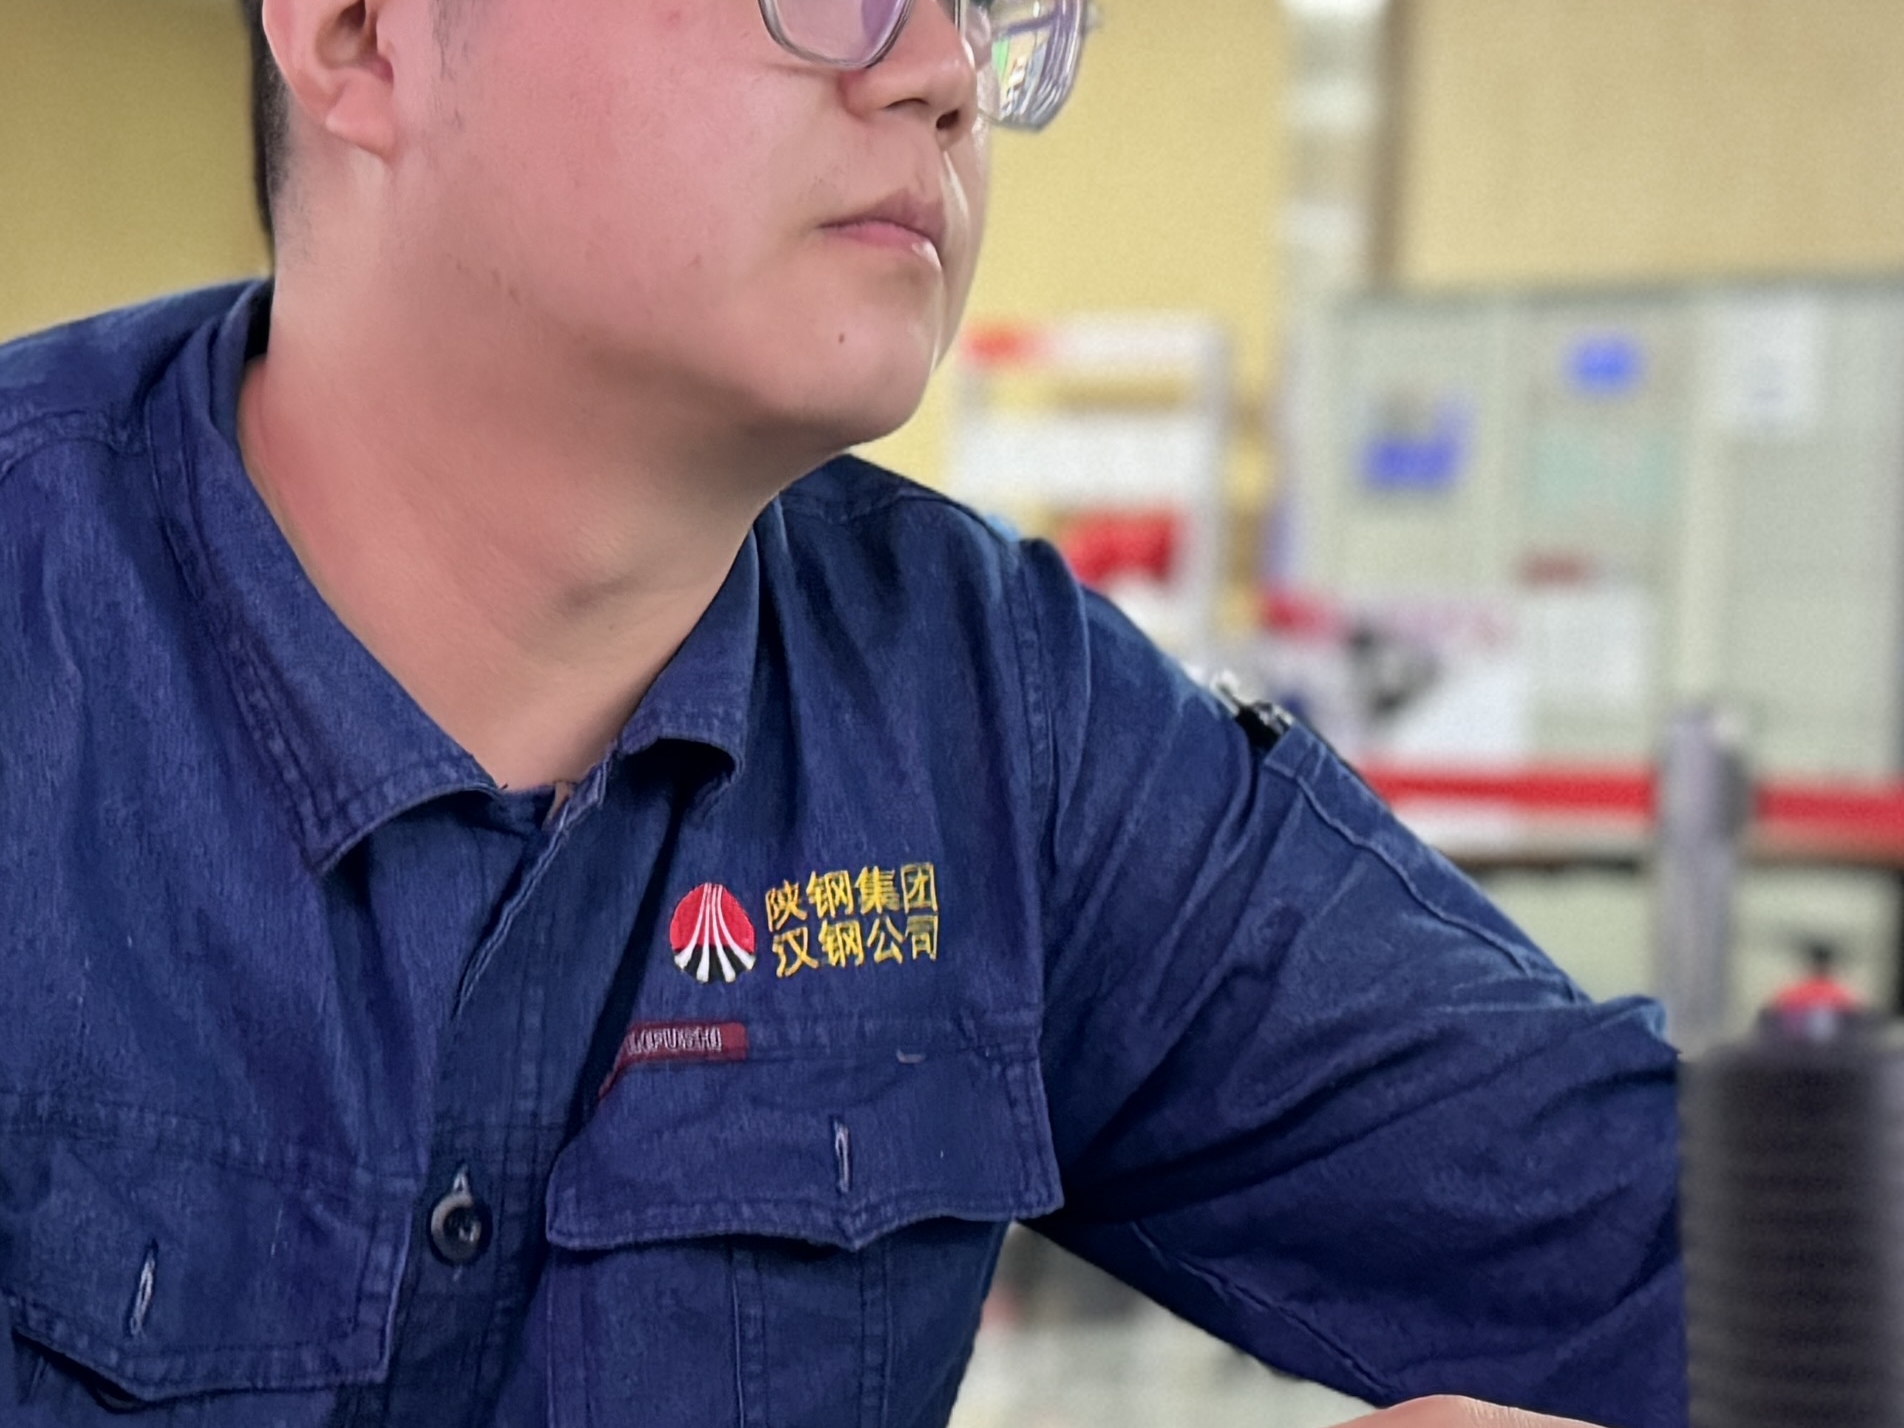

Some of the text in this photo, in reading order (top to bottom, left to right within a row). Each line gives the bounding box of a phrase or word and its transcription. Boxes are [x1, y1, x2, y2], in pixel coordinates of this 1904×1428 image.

[765, 862, 938, 932] 陕钢集团
[772, 914, 938, 978] 汉钢公司
